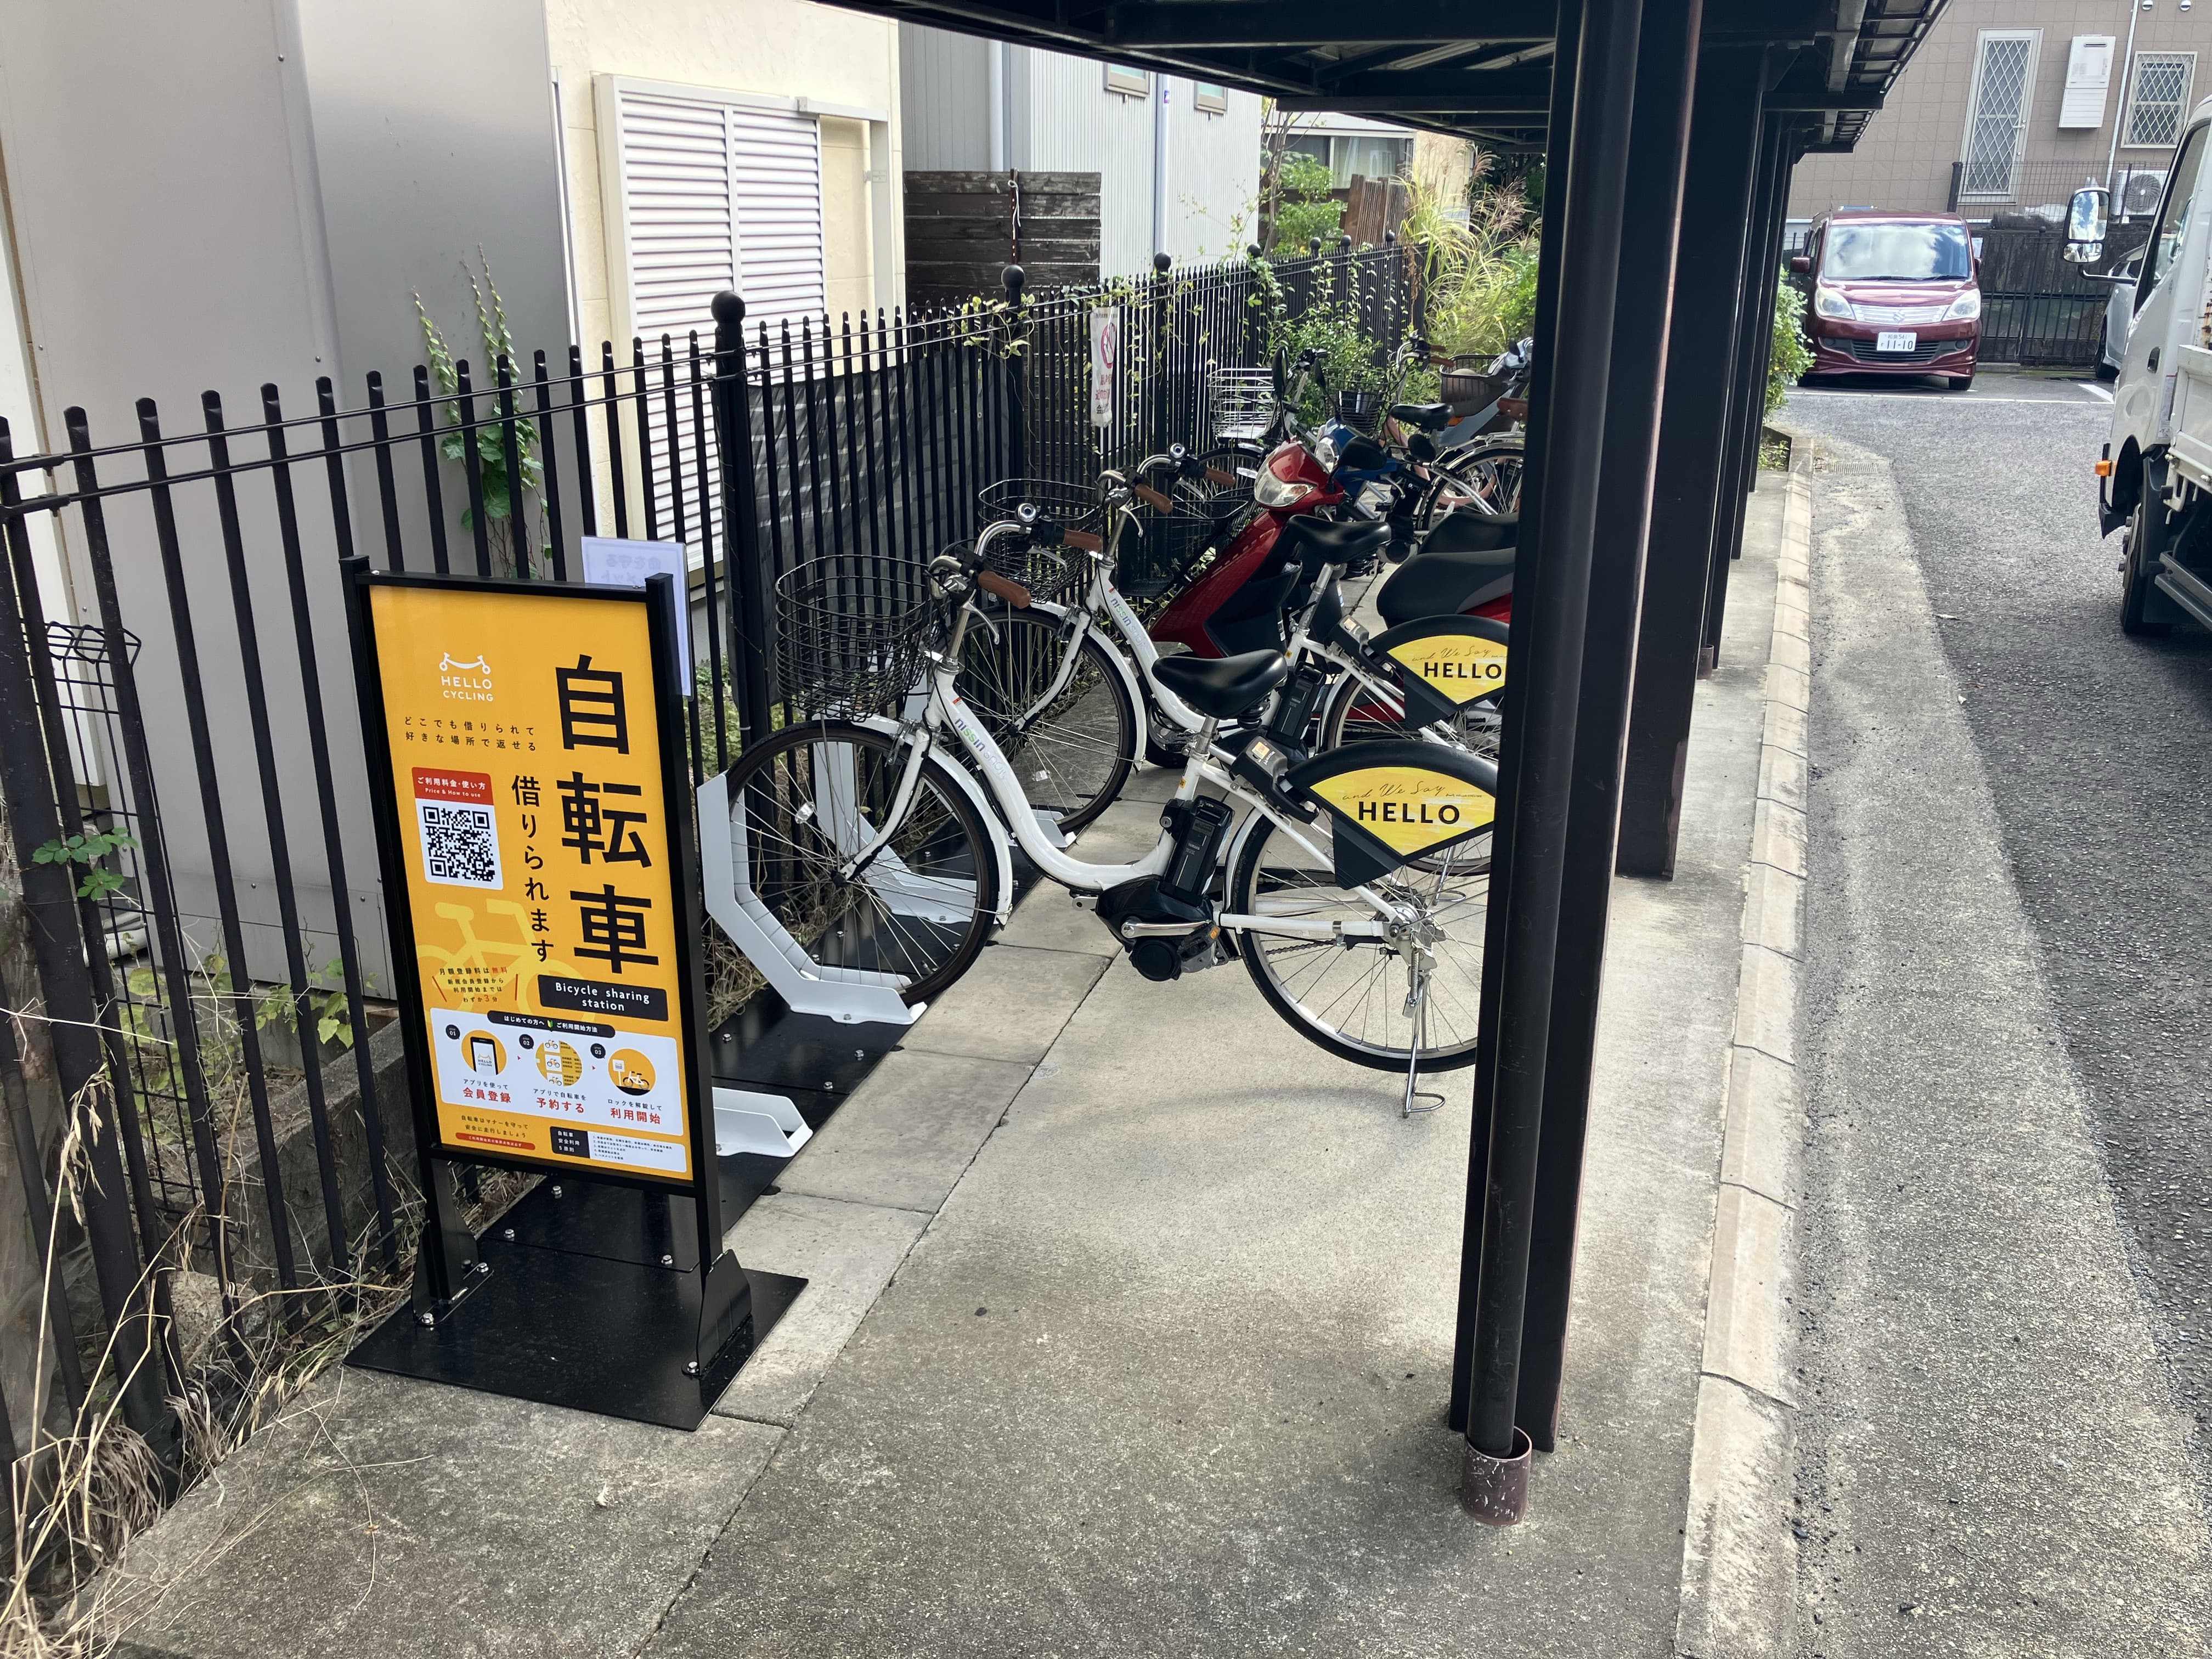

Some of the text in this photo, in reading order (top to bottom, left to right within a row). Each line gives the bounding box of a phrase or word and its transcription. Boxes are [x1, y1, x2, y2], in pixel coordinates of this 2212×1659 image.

[1887, 340, 1913, 349] 11-10
[1412, 646, 1491, 662] and We Say
[1424, 662, 1502, 679] HELLO
[441, 676, 492, 689] HELLO
[443, 690, 494, 702] CYCLING
[405, 716, 534, 735] どこでも借りられて
[405, 731, 535, 751] 好きな場所で返せる
[955, 718, 986, 752] nissin
[417, 777, 486, 790] ご利用料金・使い方
[1342, 781, 1446, 800] and We Say
[555, 654, 659, 974] 自転車
[1358, 802, 1460, 824] HELLO
[511, 775, 554, 962] 借りられます
[556, 982, 650, 1005] Bicycle sharing
[582, 999, 625, 1011] station
[504, 1015, 598, 1033] はじめての方へ ご利用開始方法
[463, 1079, 508, 1090] アプリを使って
[463, 1087, 511, 1103] 会員登録
[533, 1088, 586, 1101] アプリで自転車を
[536, 1097, 584, 1113] 予約する
[608, 1099, 662, 1111] ロックを解錠して
[610, 1108, 661, 1124] 利用開始
